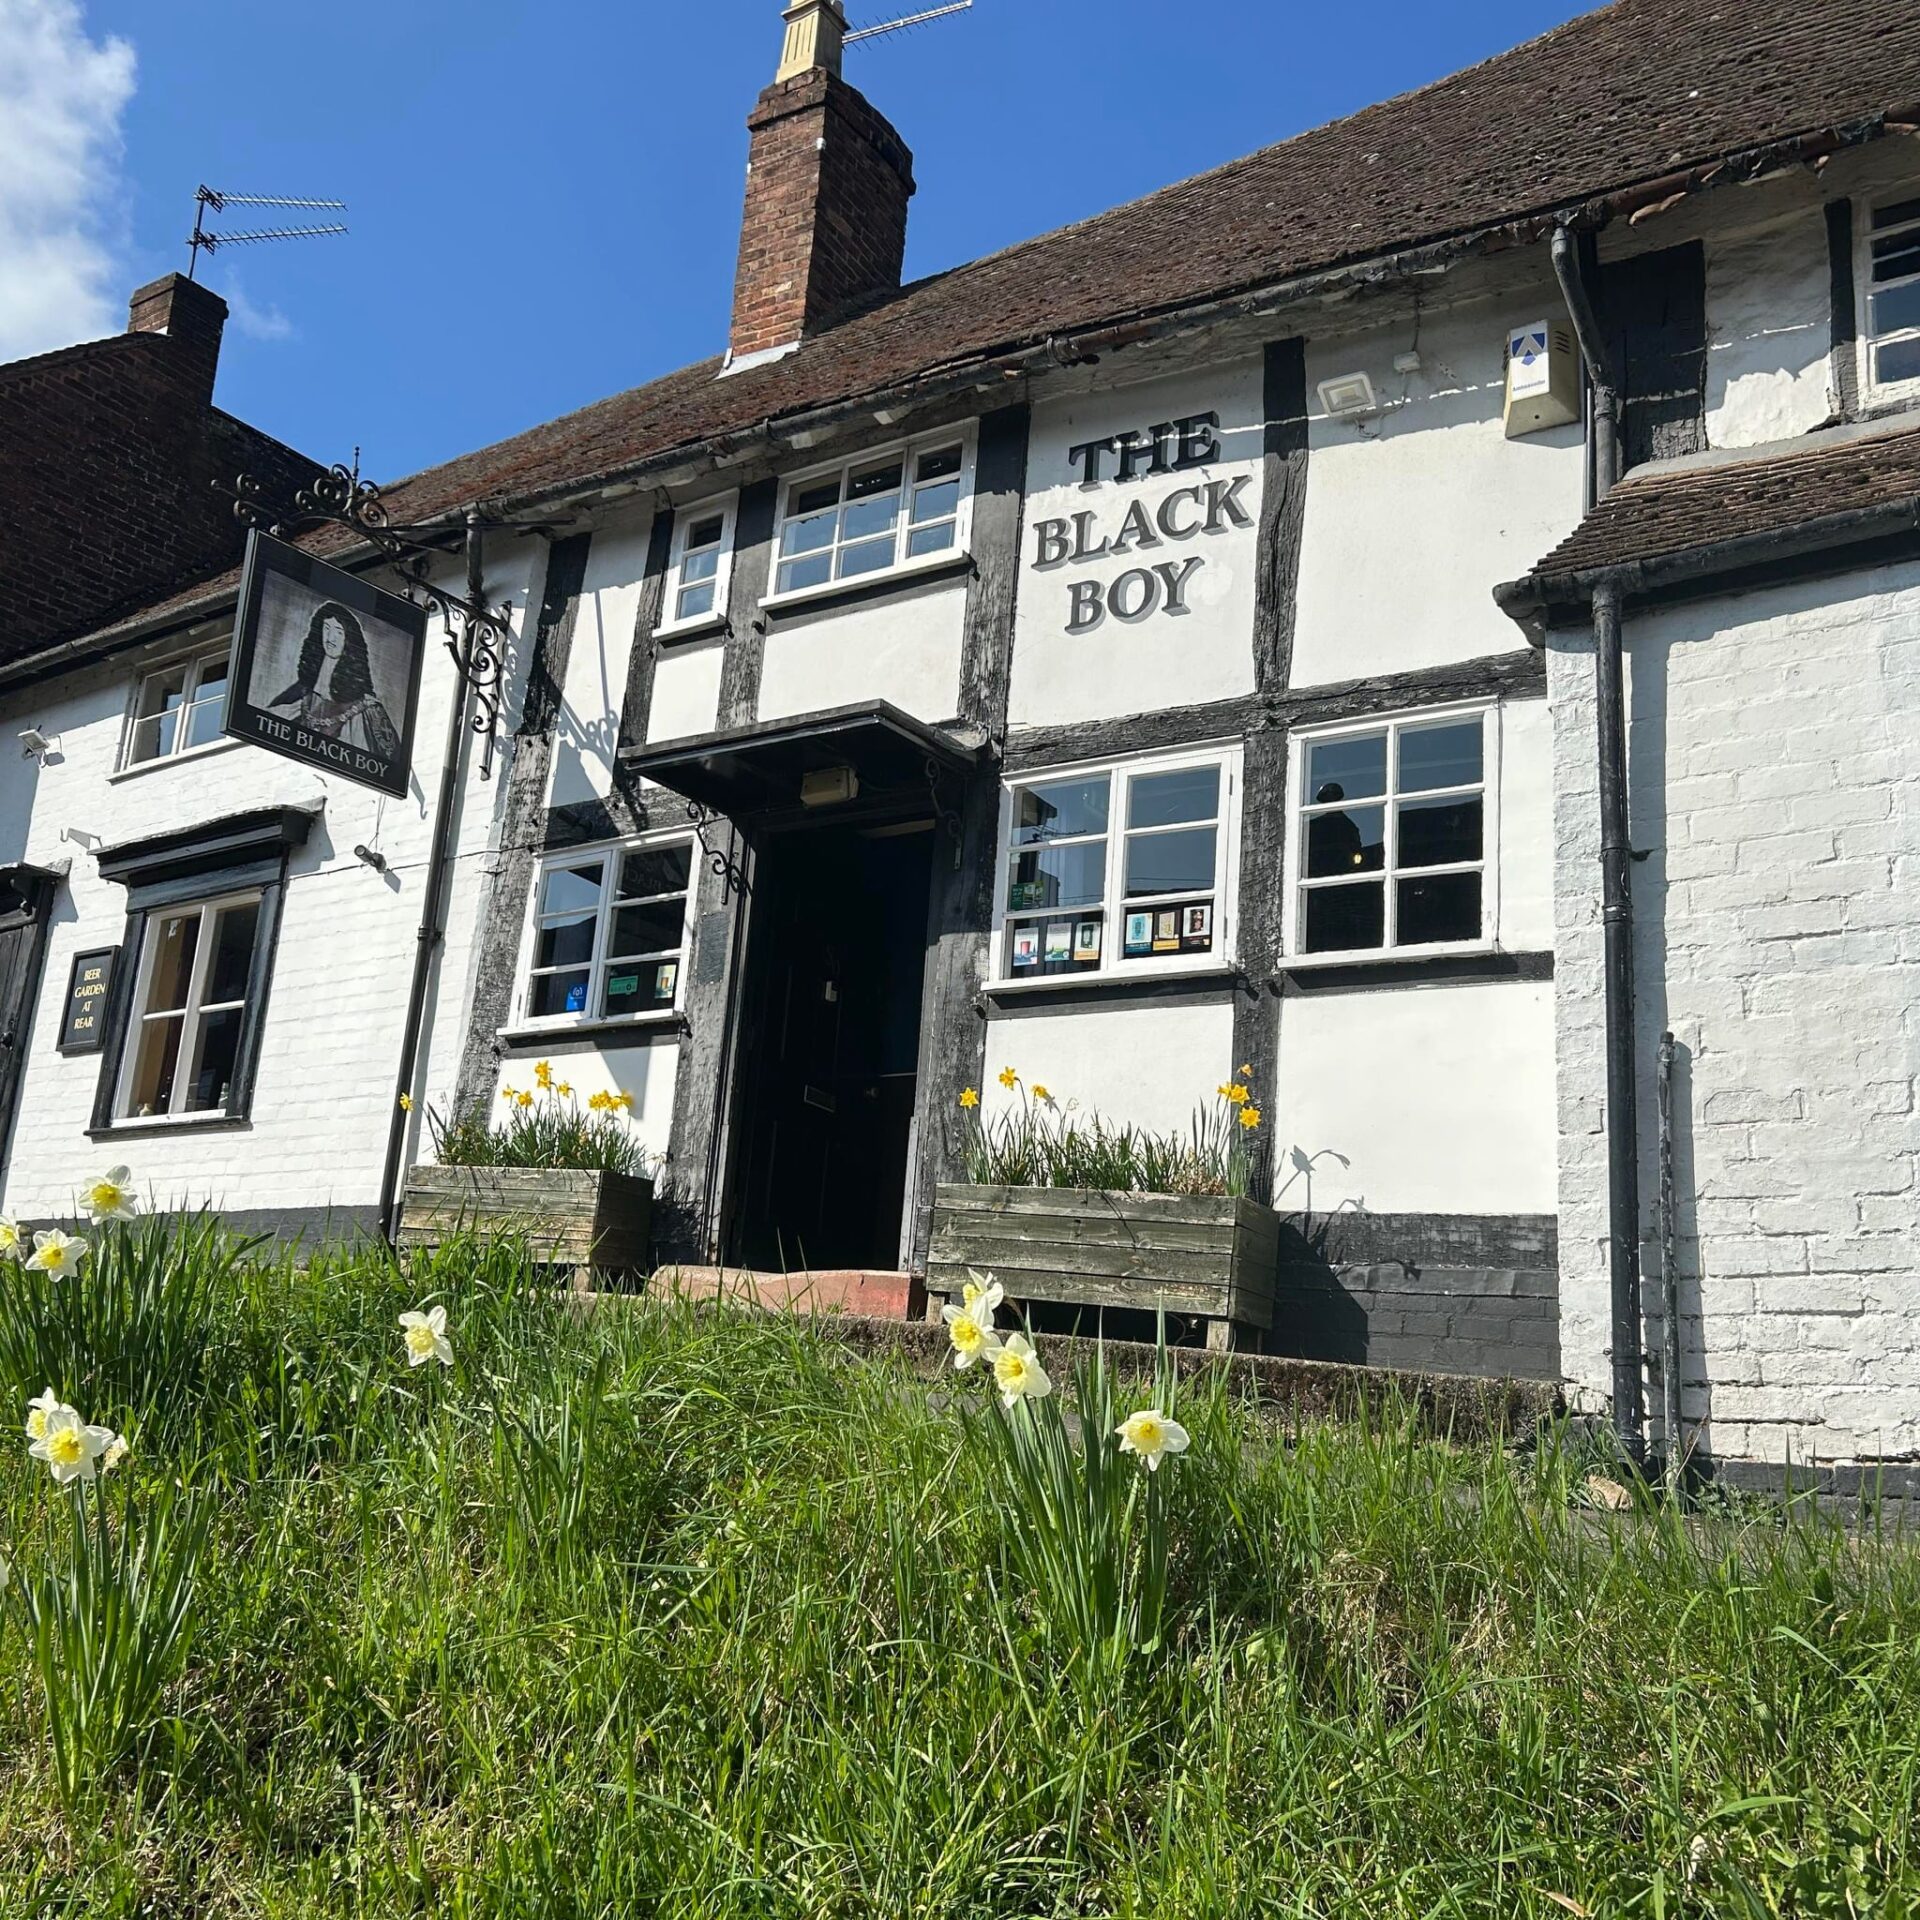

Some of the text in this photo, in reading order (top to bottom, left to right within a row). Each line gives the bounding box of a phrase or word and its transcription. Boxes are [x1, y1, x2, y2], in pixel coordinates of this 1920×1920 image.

[1068, 410, 1221, 493] THE
[1031, 474, 1255, 572] BLACK
[1064, 556, 1205, 635] BOY
[256, 714, 389, 777] THE BLACK BOY
[74, 983, 106, 998] GARDEN
[84, 968, 101, 981] BEER
[74, 1016, 94, 1030] REAR
[81, 1001, 92, 1012] AT
